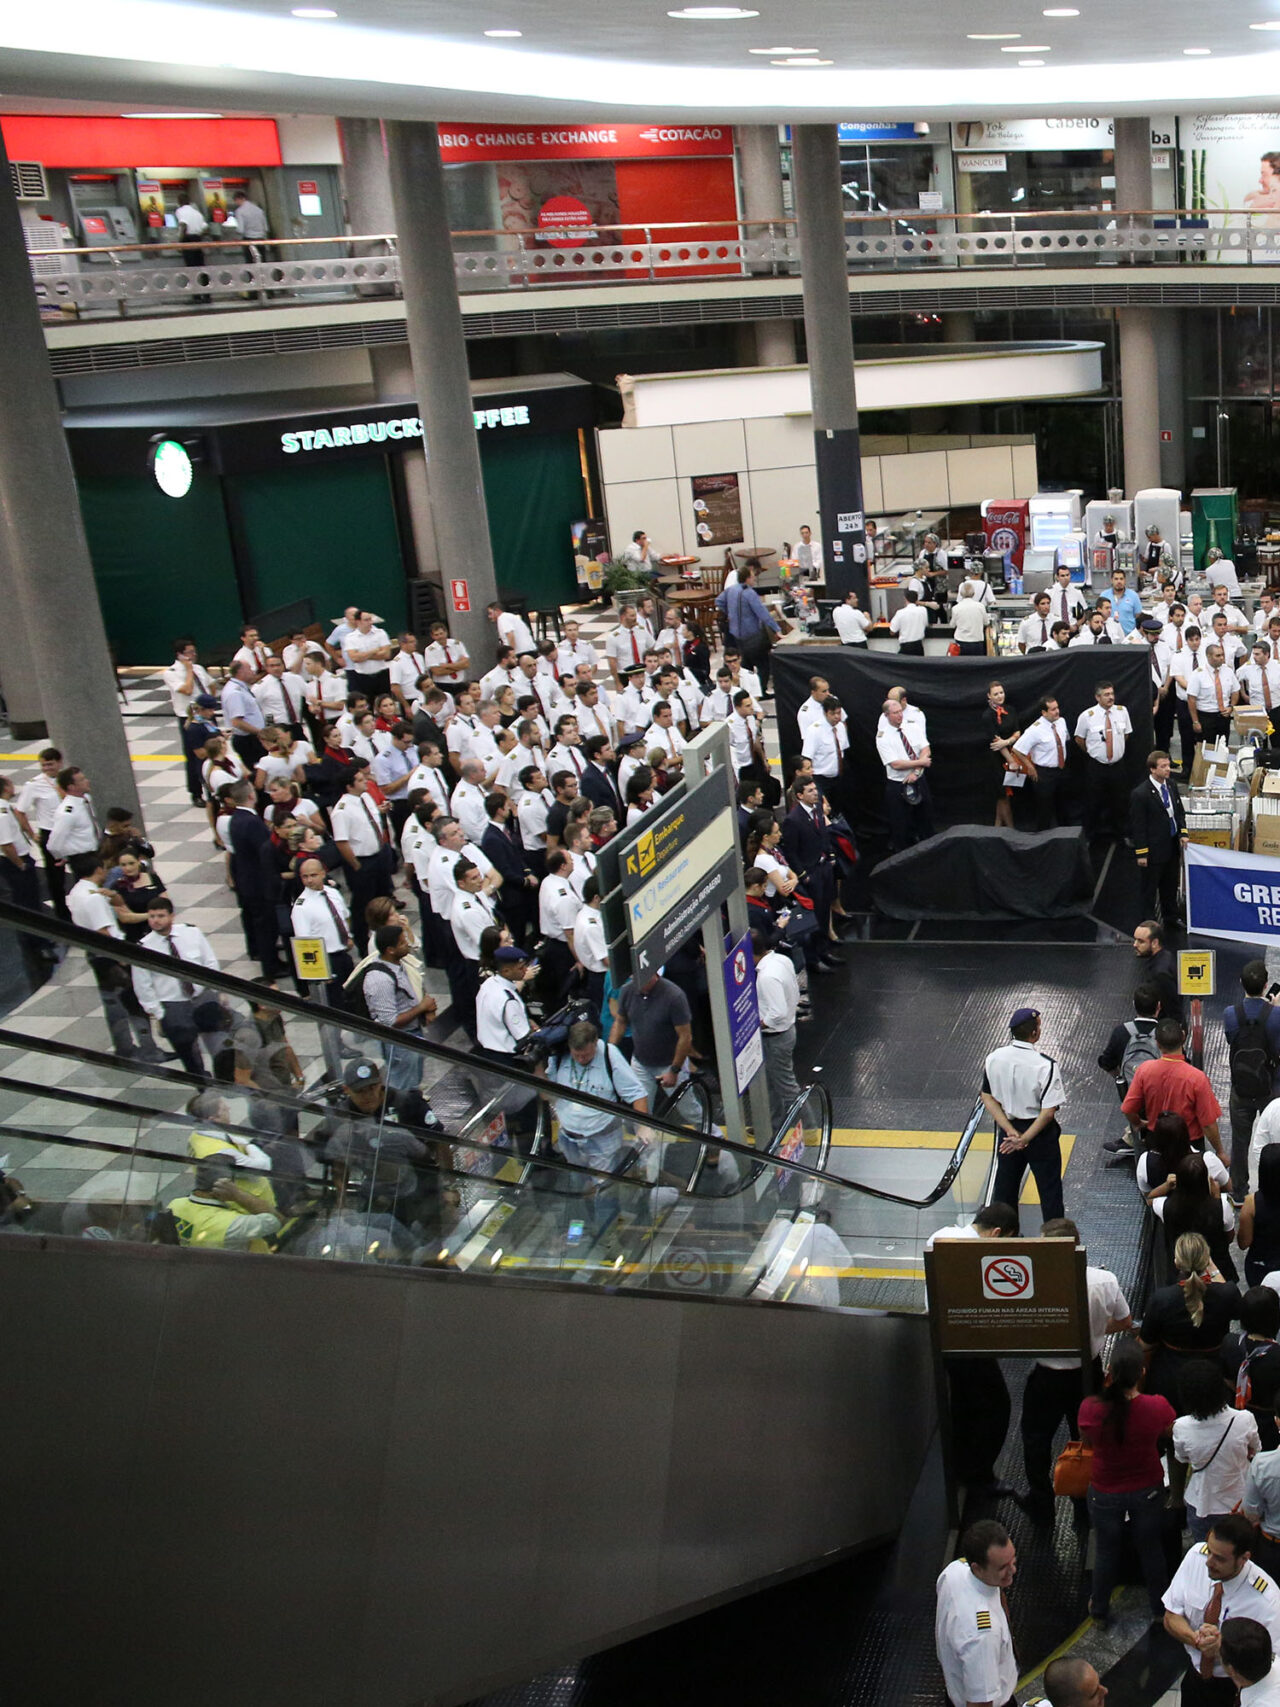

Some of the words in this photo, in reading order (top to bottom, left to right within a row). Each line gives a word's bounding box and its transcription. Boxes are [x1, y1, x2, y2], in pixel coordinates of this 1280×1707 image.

[438, 133, 470, 148] BIO
[475, 131, 536, 146] CHANGE
[541, 129, 618, 145] EXCHANGE
[1151, 130, 1171, 144] ba
[960, 158, 1003, 168] MANICURE
[472, 405, 531, 430] FFEE
[838, 514, 862, 522] ABERTO
[654, 813, 686, 846] Embarque
[663, 897, 699, 939] Administração
